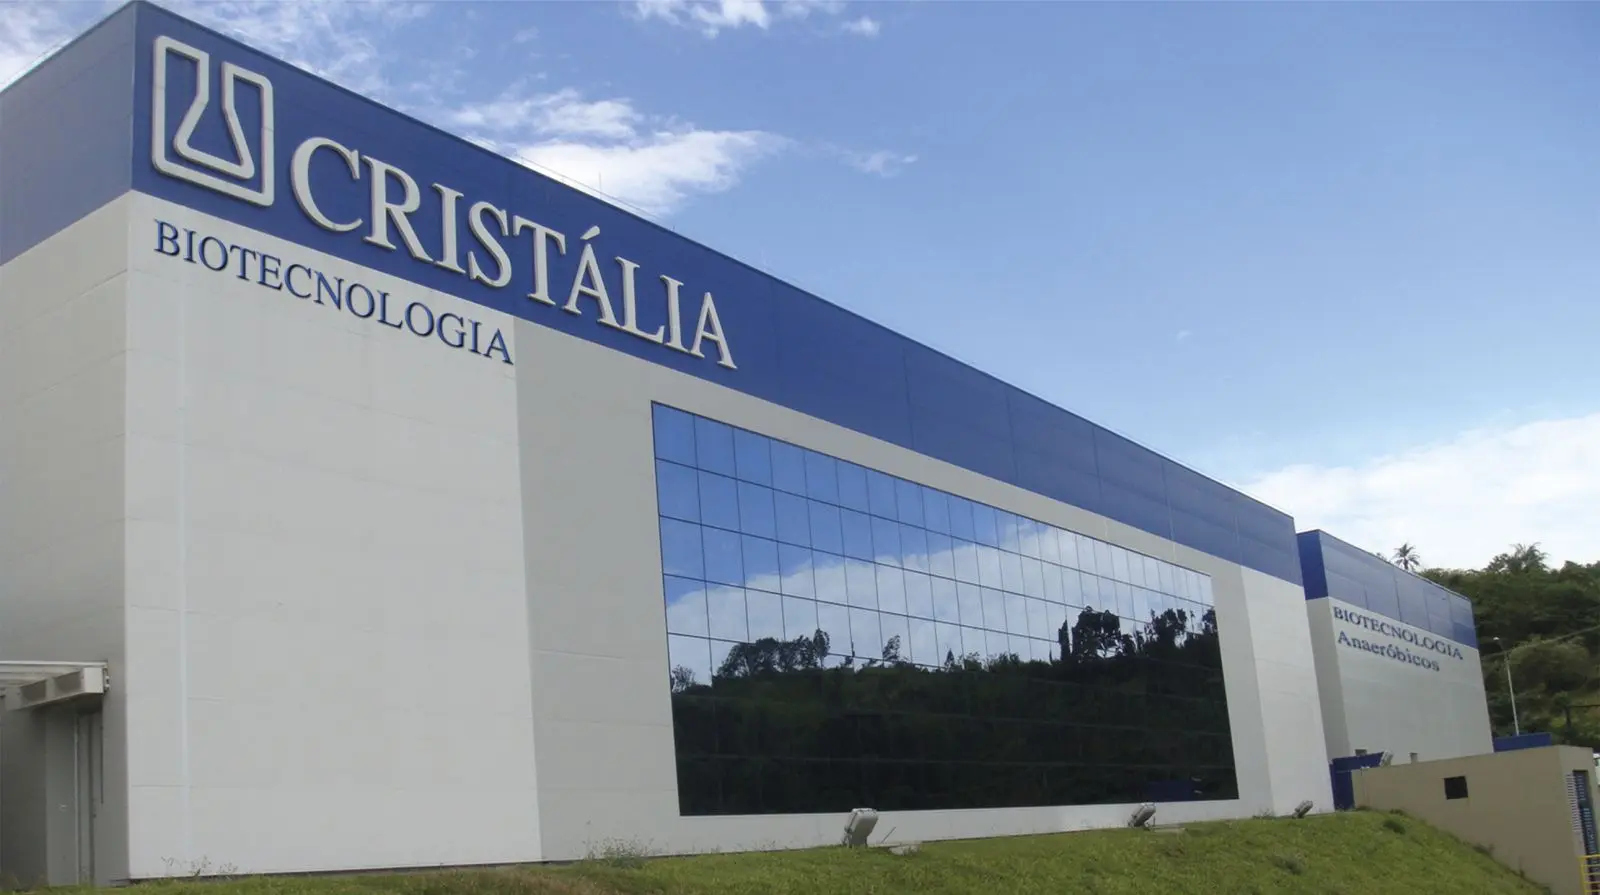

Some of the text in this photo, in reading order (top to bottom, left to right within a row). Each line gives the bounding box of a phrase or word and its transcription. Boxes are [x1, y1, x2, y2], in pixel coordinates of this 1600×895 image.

[153, 218, 514, 365] BIOTECNOLOGIA
[291, 137, 737, 369] CRISTÁLIA
[1333, 606, 1463, 660] BIOTECNOLOGIA
[1337, 630, 1440, 672] Anaeróbicos
